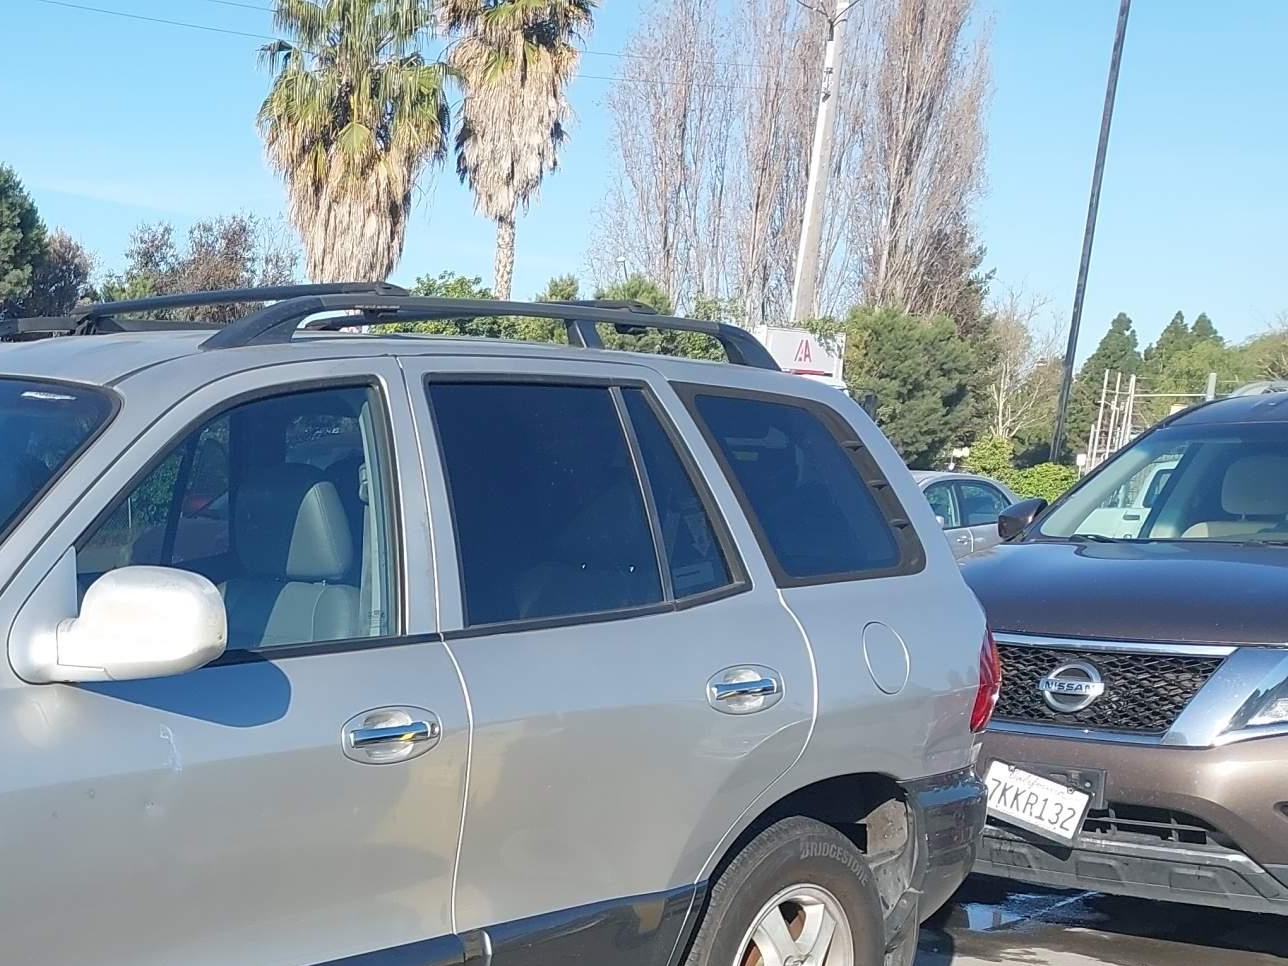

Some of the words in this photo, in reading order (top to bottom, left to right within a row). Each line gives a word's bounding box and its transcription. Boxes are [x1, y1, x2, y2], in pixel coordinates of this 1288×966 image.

[1044, 680, 1097, 692] NISSAN
[988, 778, 1076, 832] 7KKR132
[799, 840, 869, 888] BRIDGESTONE
